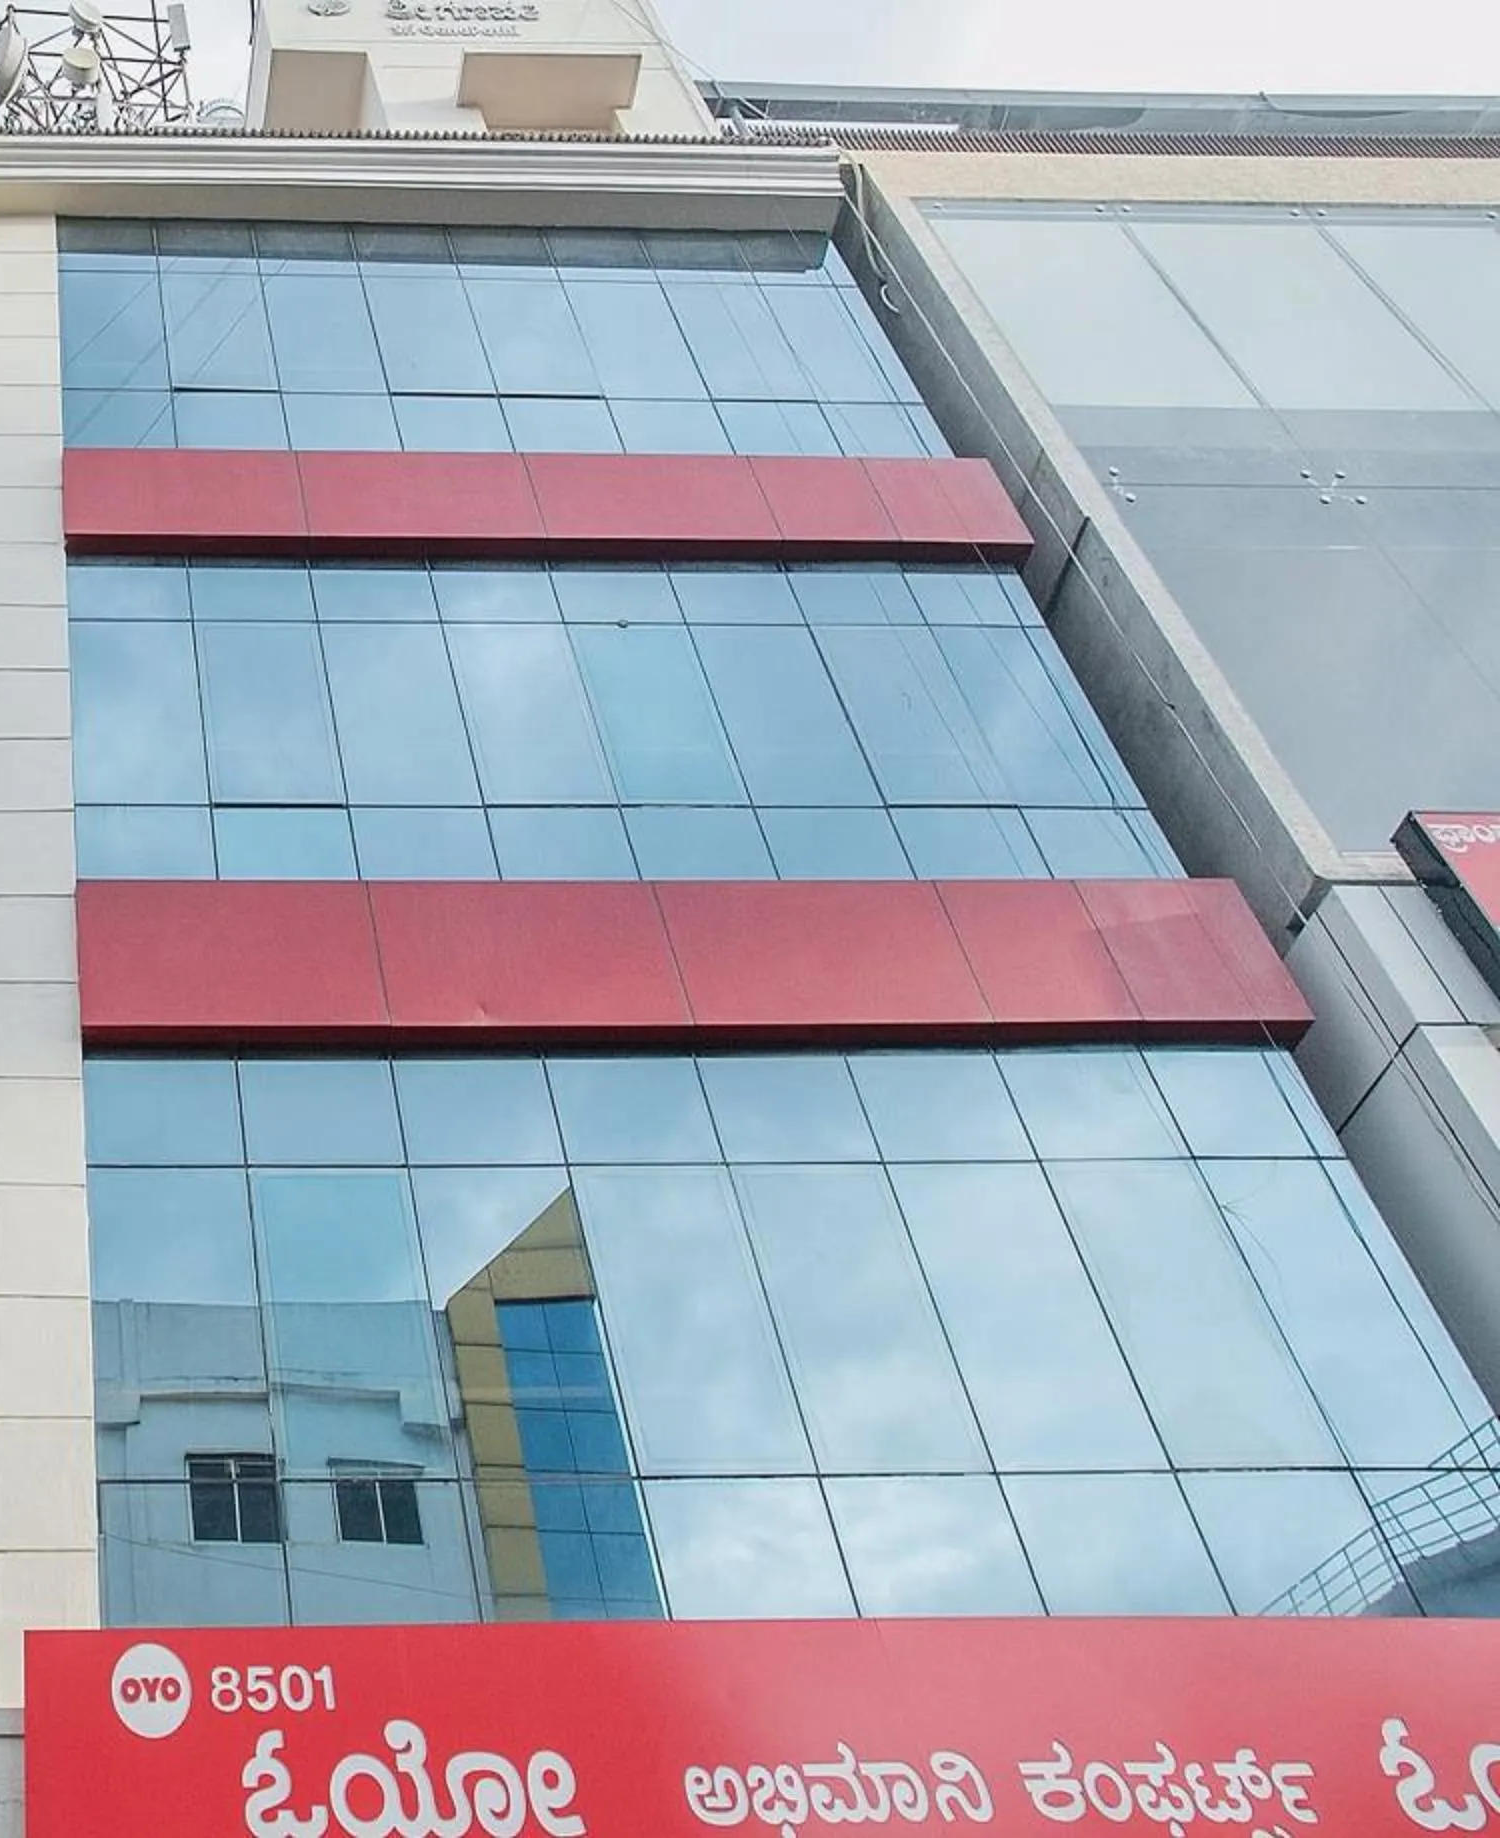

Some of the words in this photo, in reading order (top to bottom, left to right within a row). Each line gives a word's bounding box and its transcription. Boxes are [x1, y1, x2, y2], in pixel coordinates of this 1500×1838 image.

[120, 1676, 182, 1704] OYO
[211, 1664, 338, 1713] 8501
[241, 1719, 587, 1838] ಓಯೋ
[684, 1741, 995, 1838] ಅಭಿಮಾನಿ
[1379, 1717, 1500, 1832] ಓ
